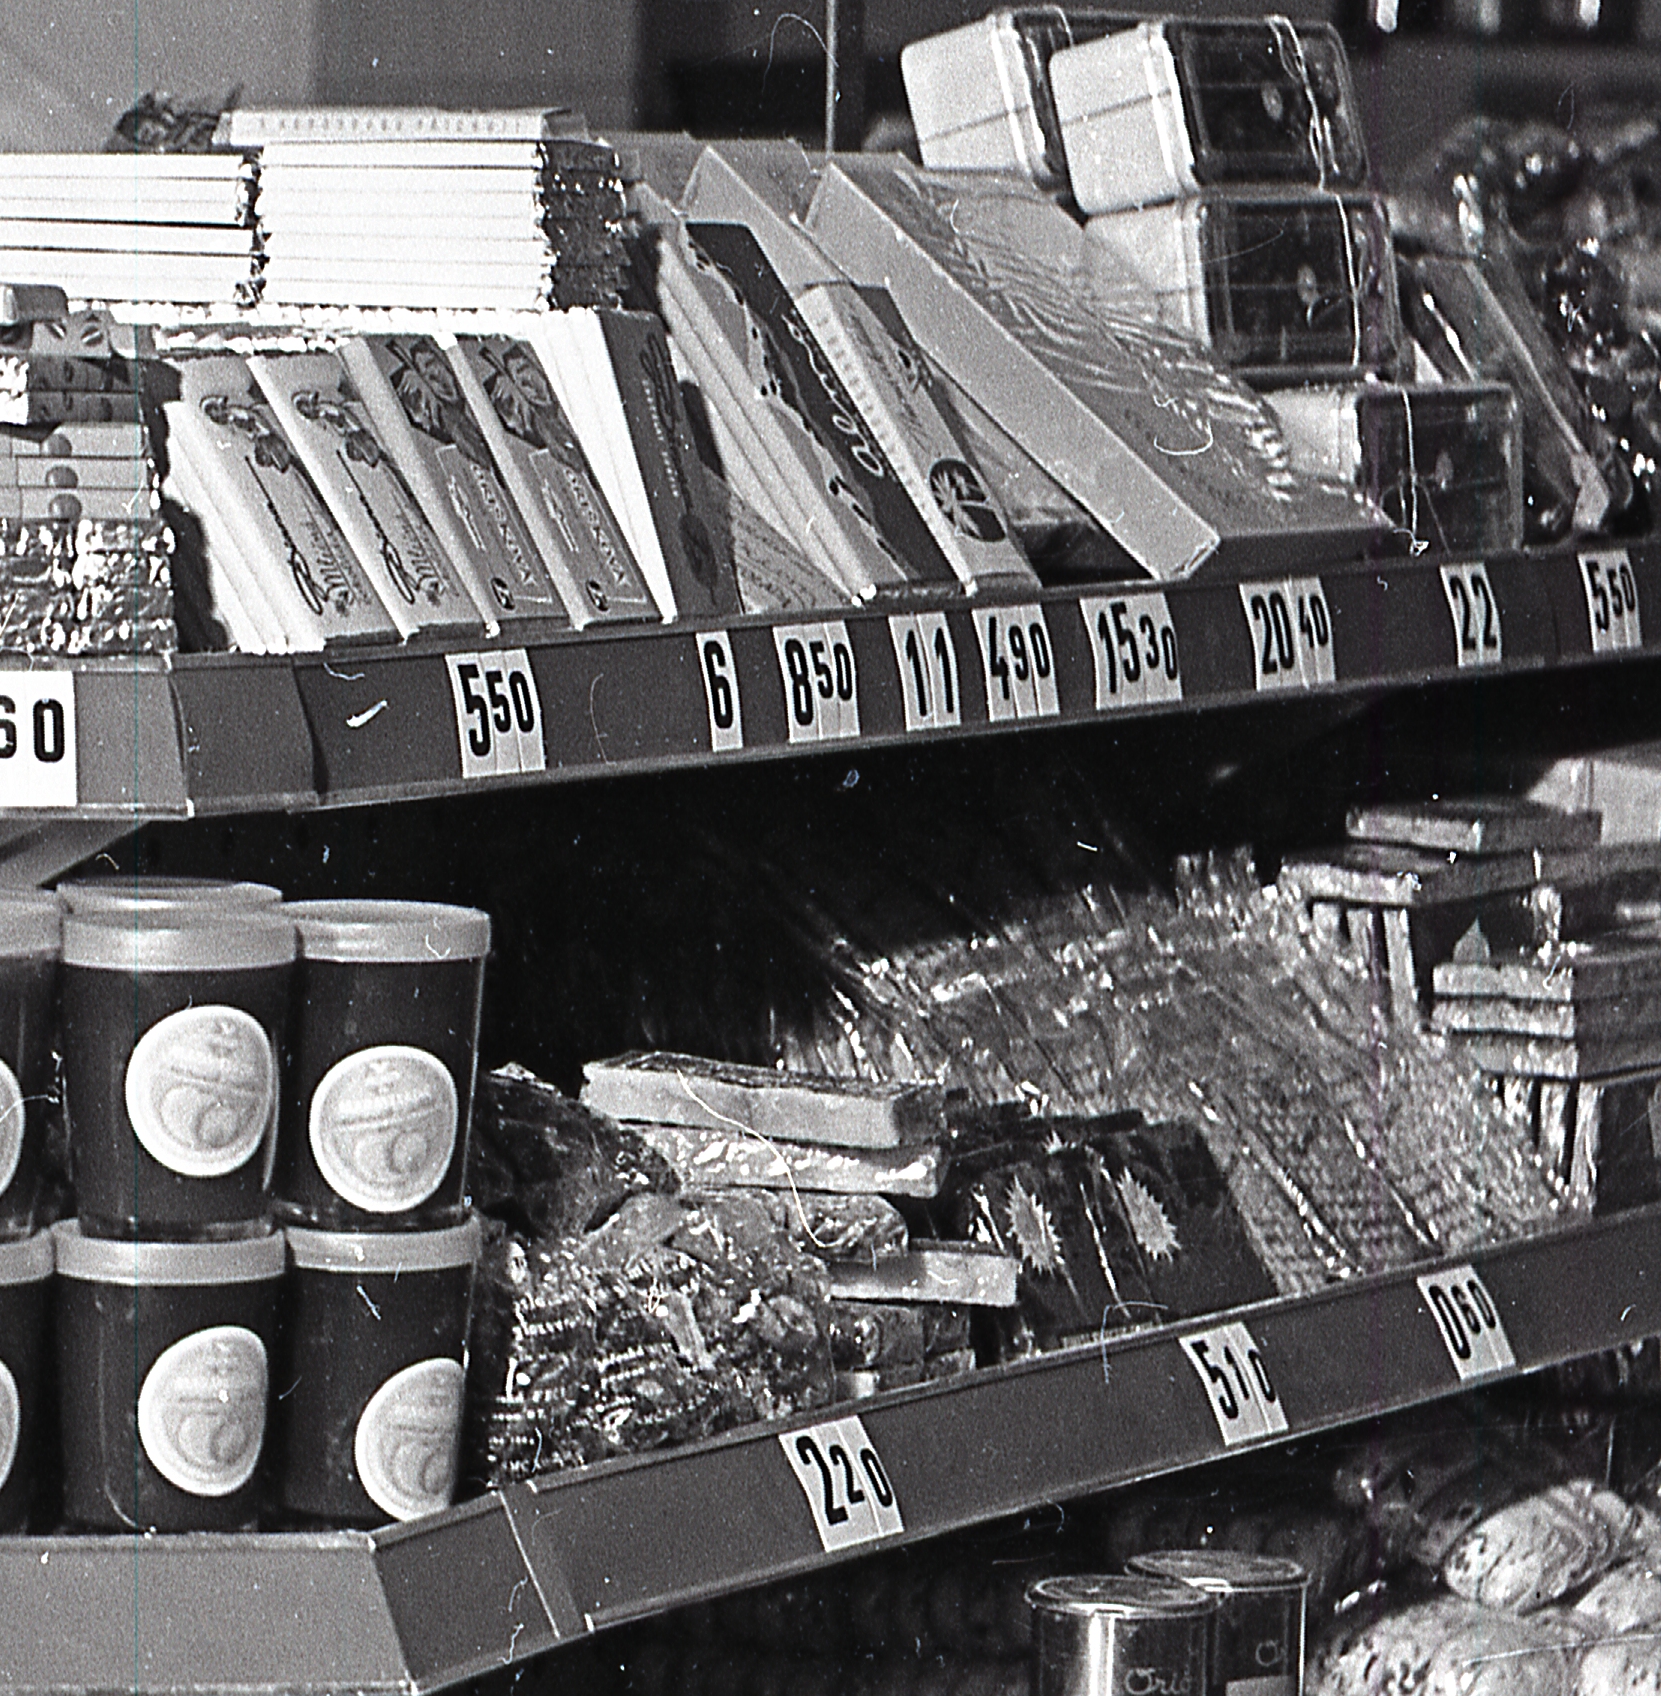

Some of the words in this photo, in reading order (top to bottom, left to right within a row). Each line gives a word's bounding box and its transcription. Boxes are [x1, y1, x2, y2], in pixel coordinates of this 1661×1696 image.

[1450, 574, 1497, 651] 22
[704, 641, 733, 729] 6
[906, 628, 954, 716] 11
